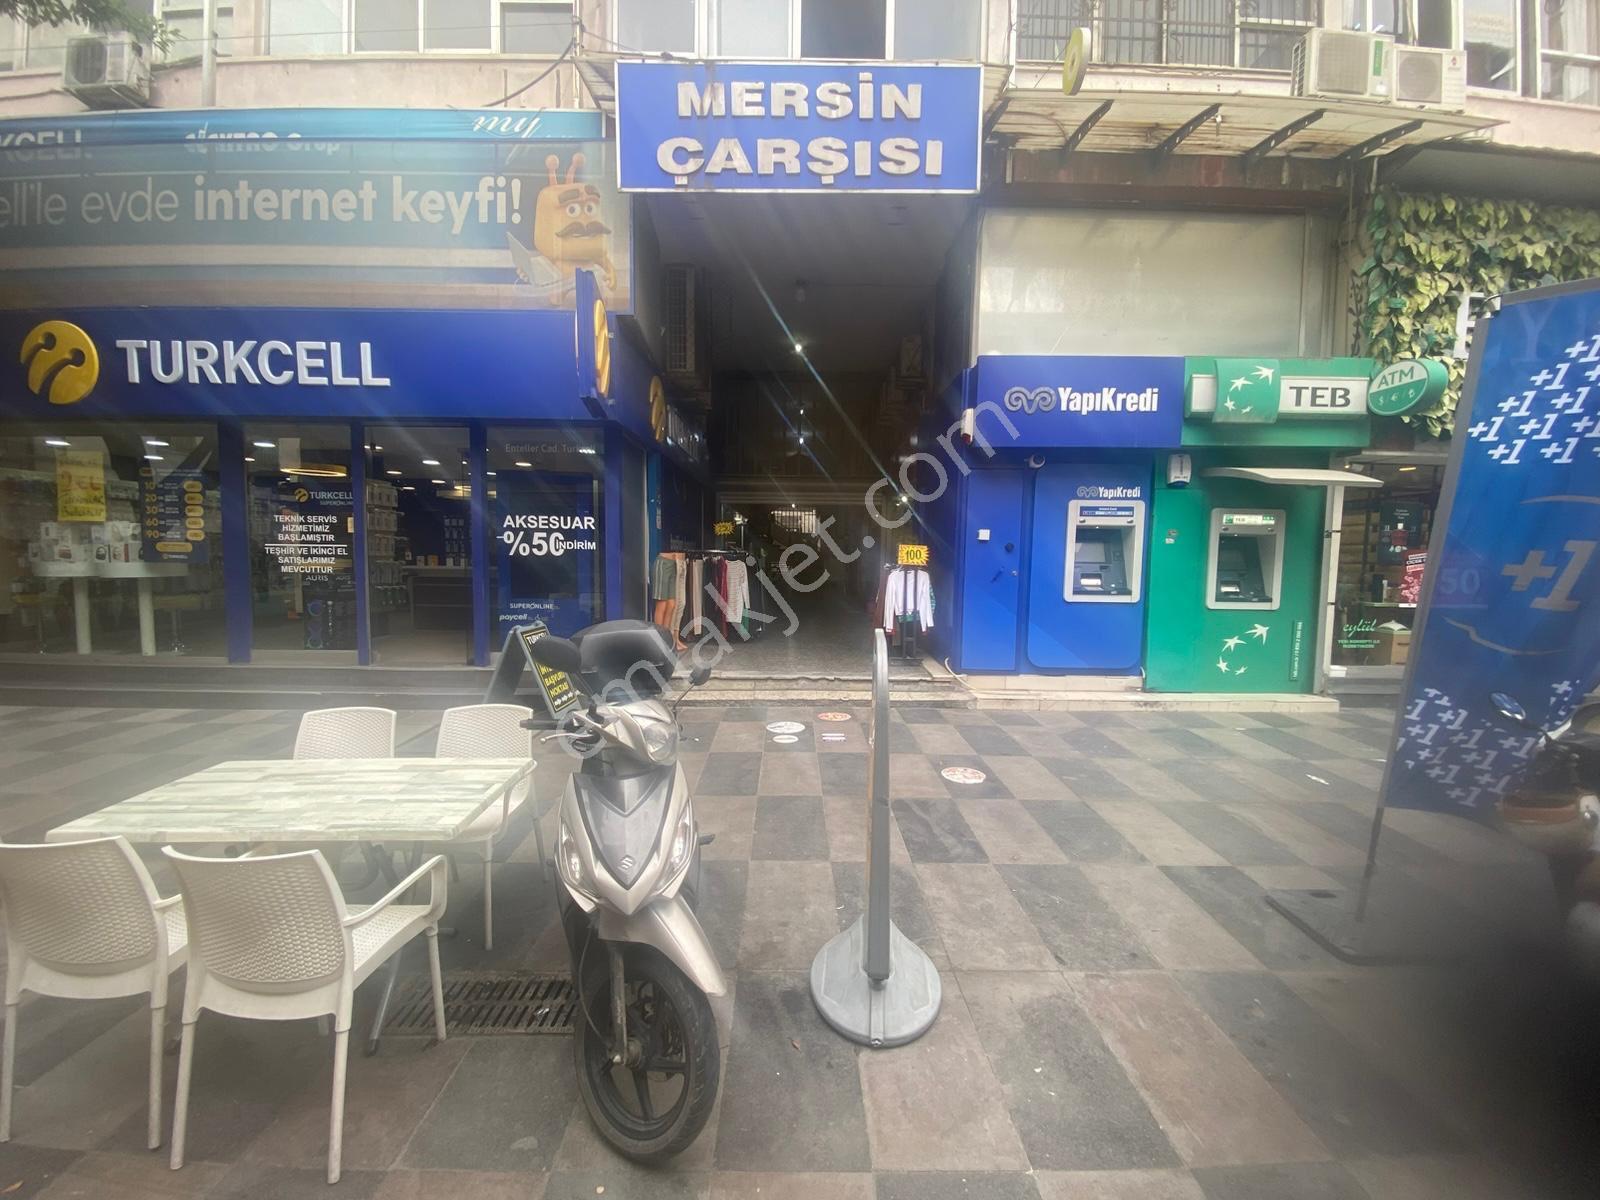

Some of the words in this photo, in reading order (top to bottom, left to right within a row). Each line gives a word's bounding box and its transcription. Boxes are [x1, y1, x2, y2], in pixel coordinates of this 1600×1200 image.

[677, 72, 922, 119] MERSİN
[657, 137, 943, 185] ÇARŞISI
[81, 176, 179, 225] evde
[195, 174, 376, 222] internet
[393, 174, 522, 233] keyfi!
[116, 339, 390, 386] TURKCELL
[1377, 366, 1415, 389] ATM
[1289, 386, 1350, 408] TEB
[273, 514, 304, 522] TEKNİK
[307, 514, 337, 523] SERVİS
[503, 515, 596, 530] AKSESUAR
[297, 547, 308, 555] VE
[337, 547, 348, 555] EL
[556, 540, 596, 550] İNDİRİM
[281, 565, 333, 574] MEVCUTTUR
[1502, 540, 1599, 611] +1
